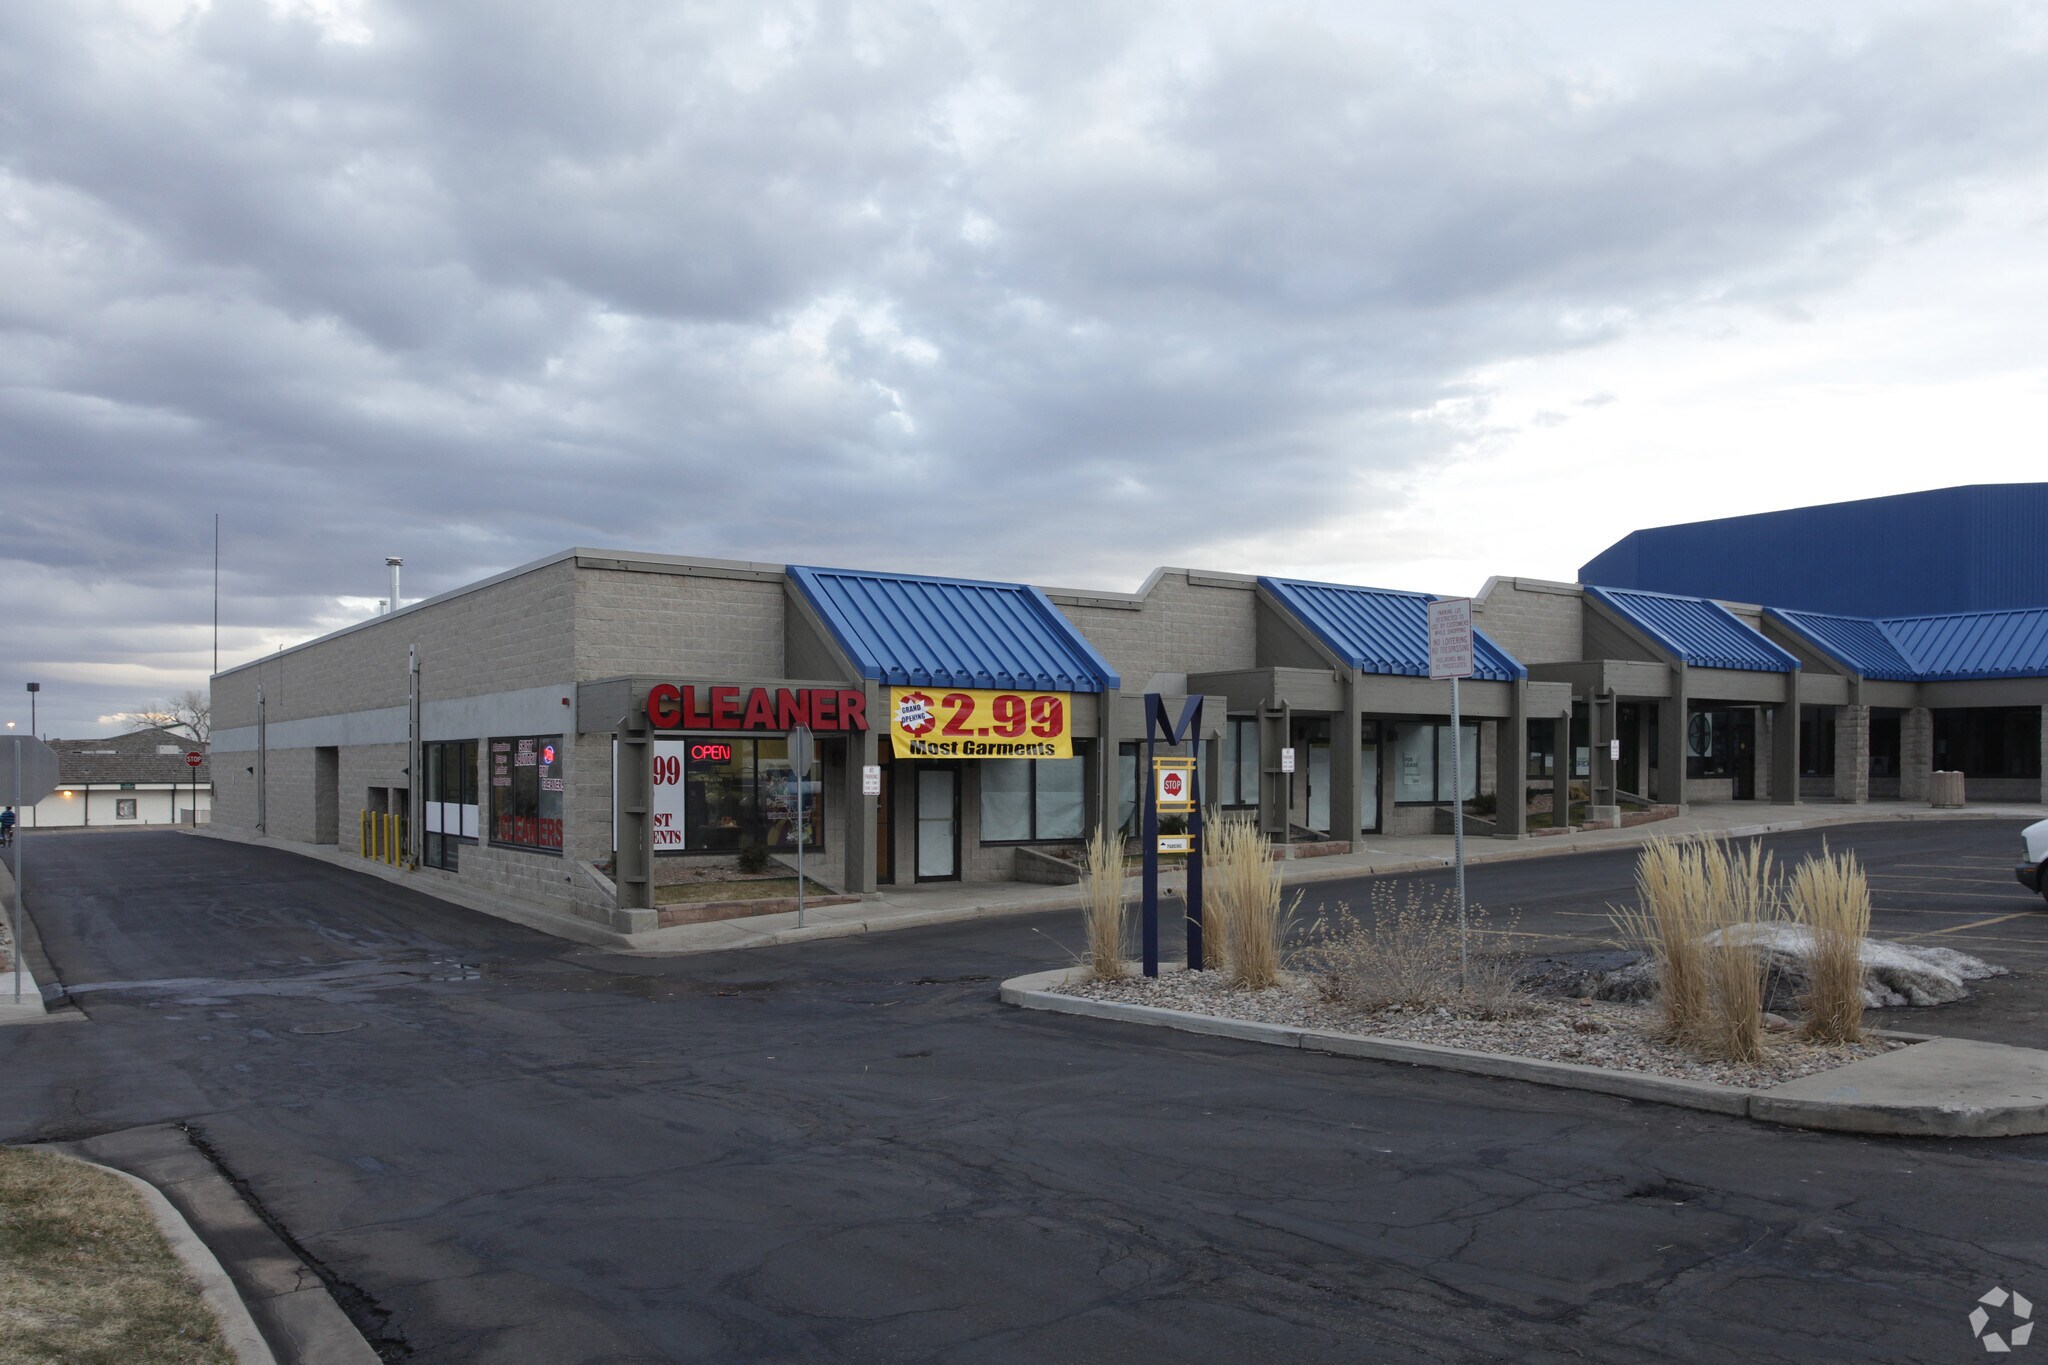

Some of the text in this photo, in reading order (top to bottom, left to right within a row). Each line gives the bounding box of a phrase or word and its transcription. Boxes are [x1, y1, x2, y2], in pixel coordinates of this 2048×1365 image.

[1436, 614, 1458, 622] RESTRICTED
[1446, 620, 1469, 628] CUSTOMERS
[1447, 627, 1467, 635] SHOPPING
[1442, 636, 1468, 646] LOITERING
[1440, 644, 1470, 654] TRESPASSING
[647, 683, 870, 730] CLEANER
[901, 704, 922, 714] GRAND
[901, 713, 926, 724] OPENING
[691, 745, 731, 760] OPEN
[909, 740, 1055, 756] Most Garments
[1164, 780, 1181, 789] STOP
[653, 813, 673, 827] ST
[499, 815, 563, 848] CLEANERS
[653, 830, 682, 844] ENTS
